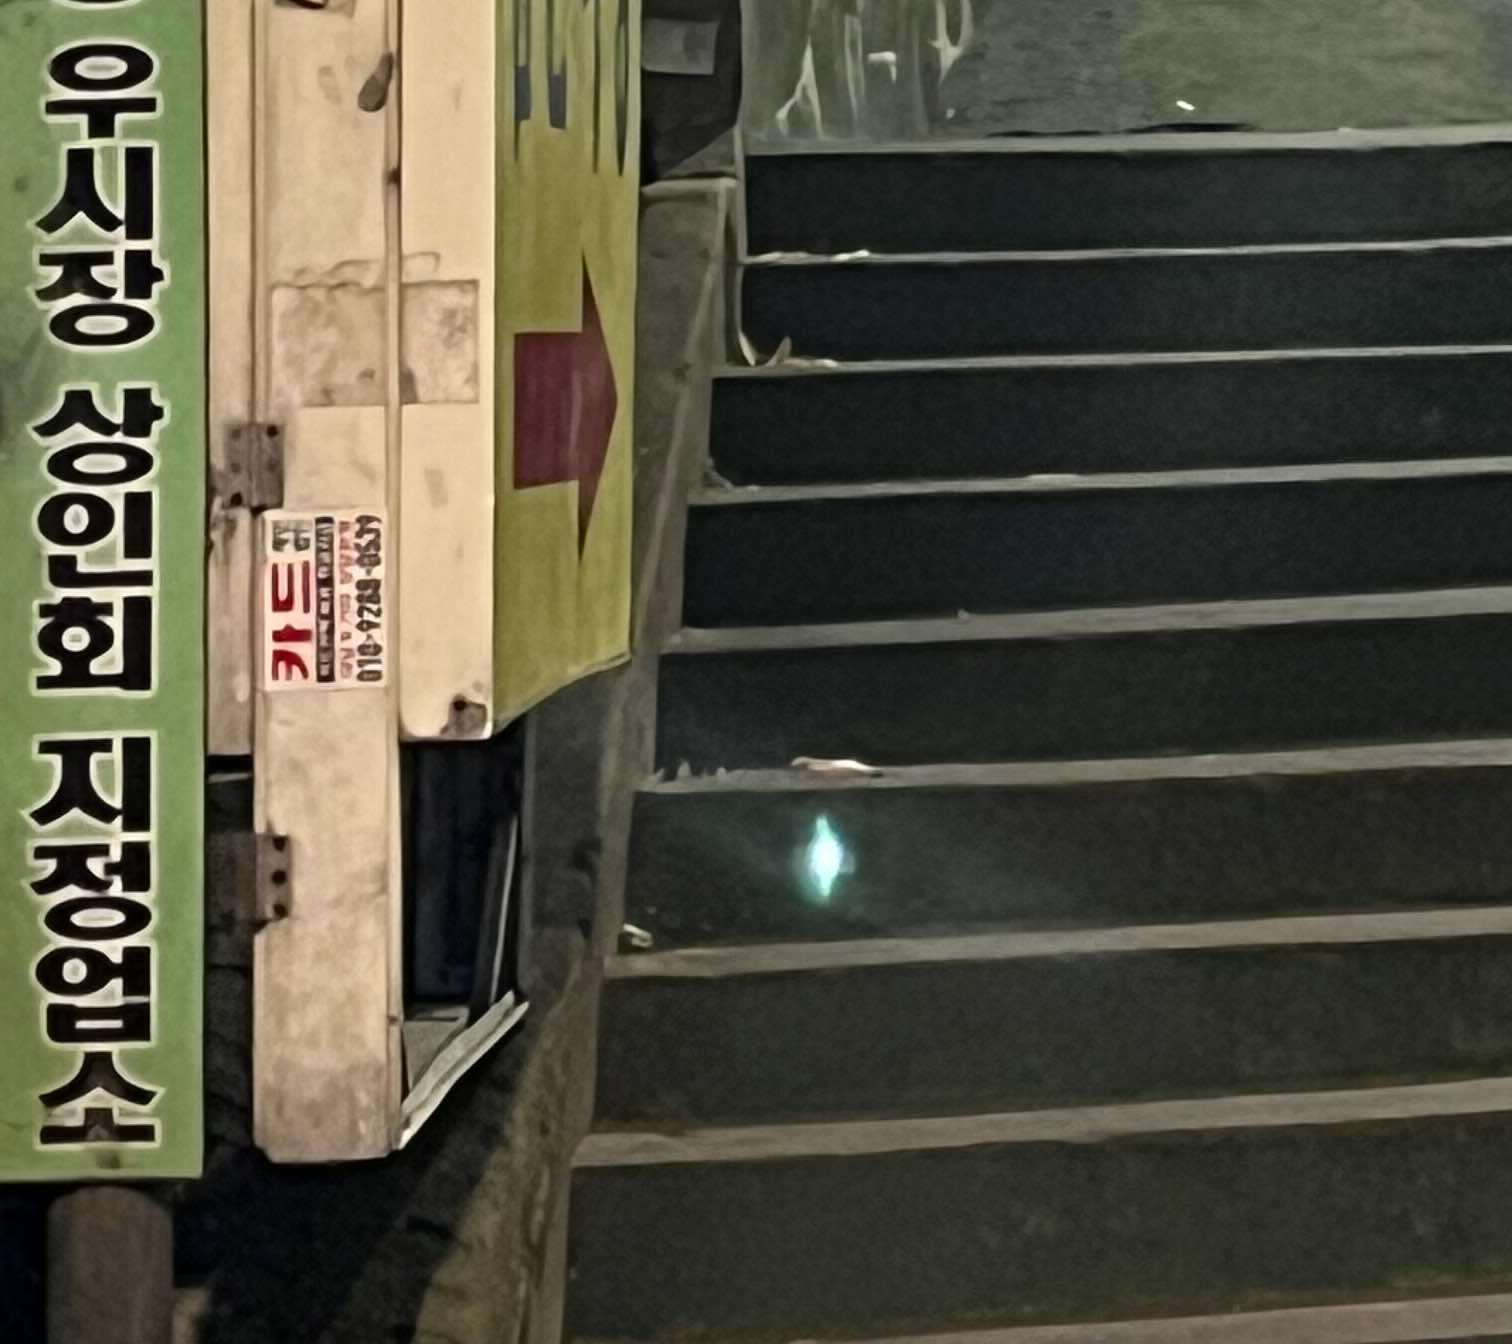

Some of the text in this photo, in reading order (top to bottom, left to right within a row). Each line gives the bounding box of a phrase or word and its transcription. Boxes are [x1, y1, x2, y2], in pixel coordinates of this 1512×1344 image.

[32, 43, 166, 348] 우시장
[30, 386, 168, 693] 상인회
[27, 735, 160, 1146] 지정업소
